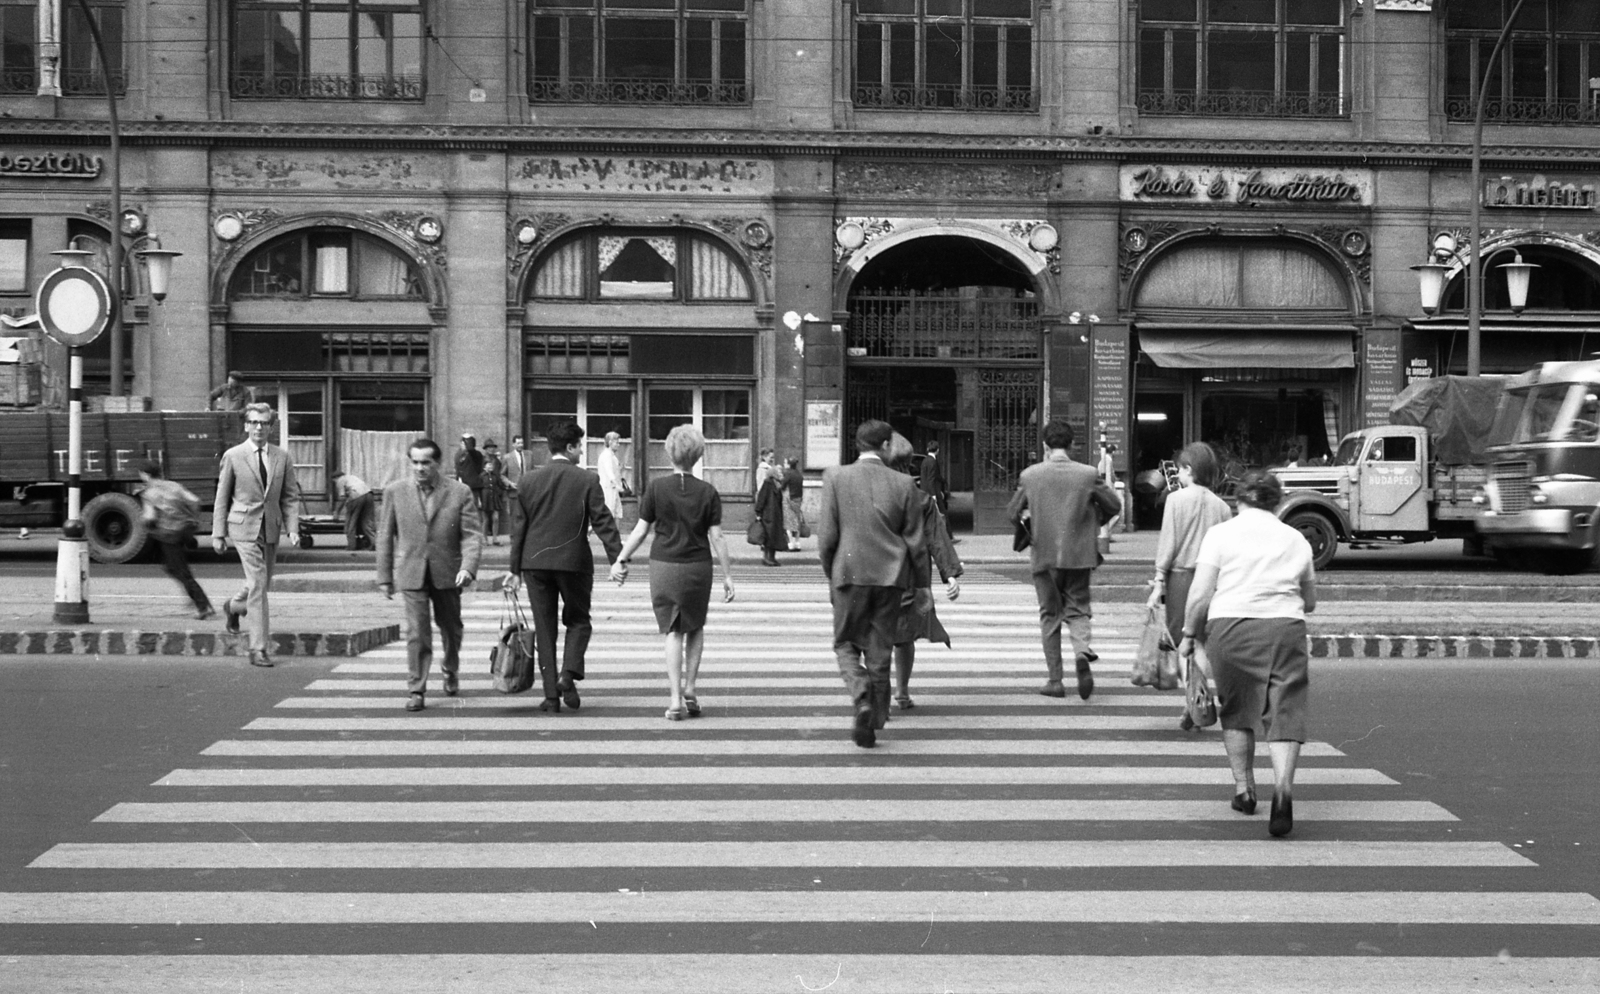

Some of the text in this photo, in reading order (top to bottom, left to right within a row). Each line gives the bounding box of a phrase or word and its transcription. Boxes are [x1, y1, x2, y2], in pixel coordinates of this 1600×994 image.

[1133, 165, 1198, 199] Kosár
[1207, 170, 1229, 199] és
[1369, 476, 1414, 485] BUDAPEST
